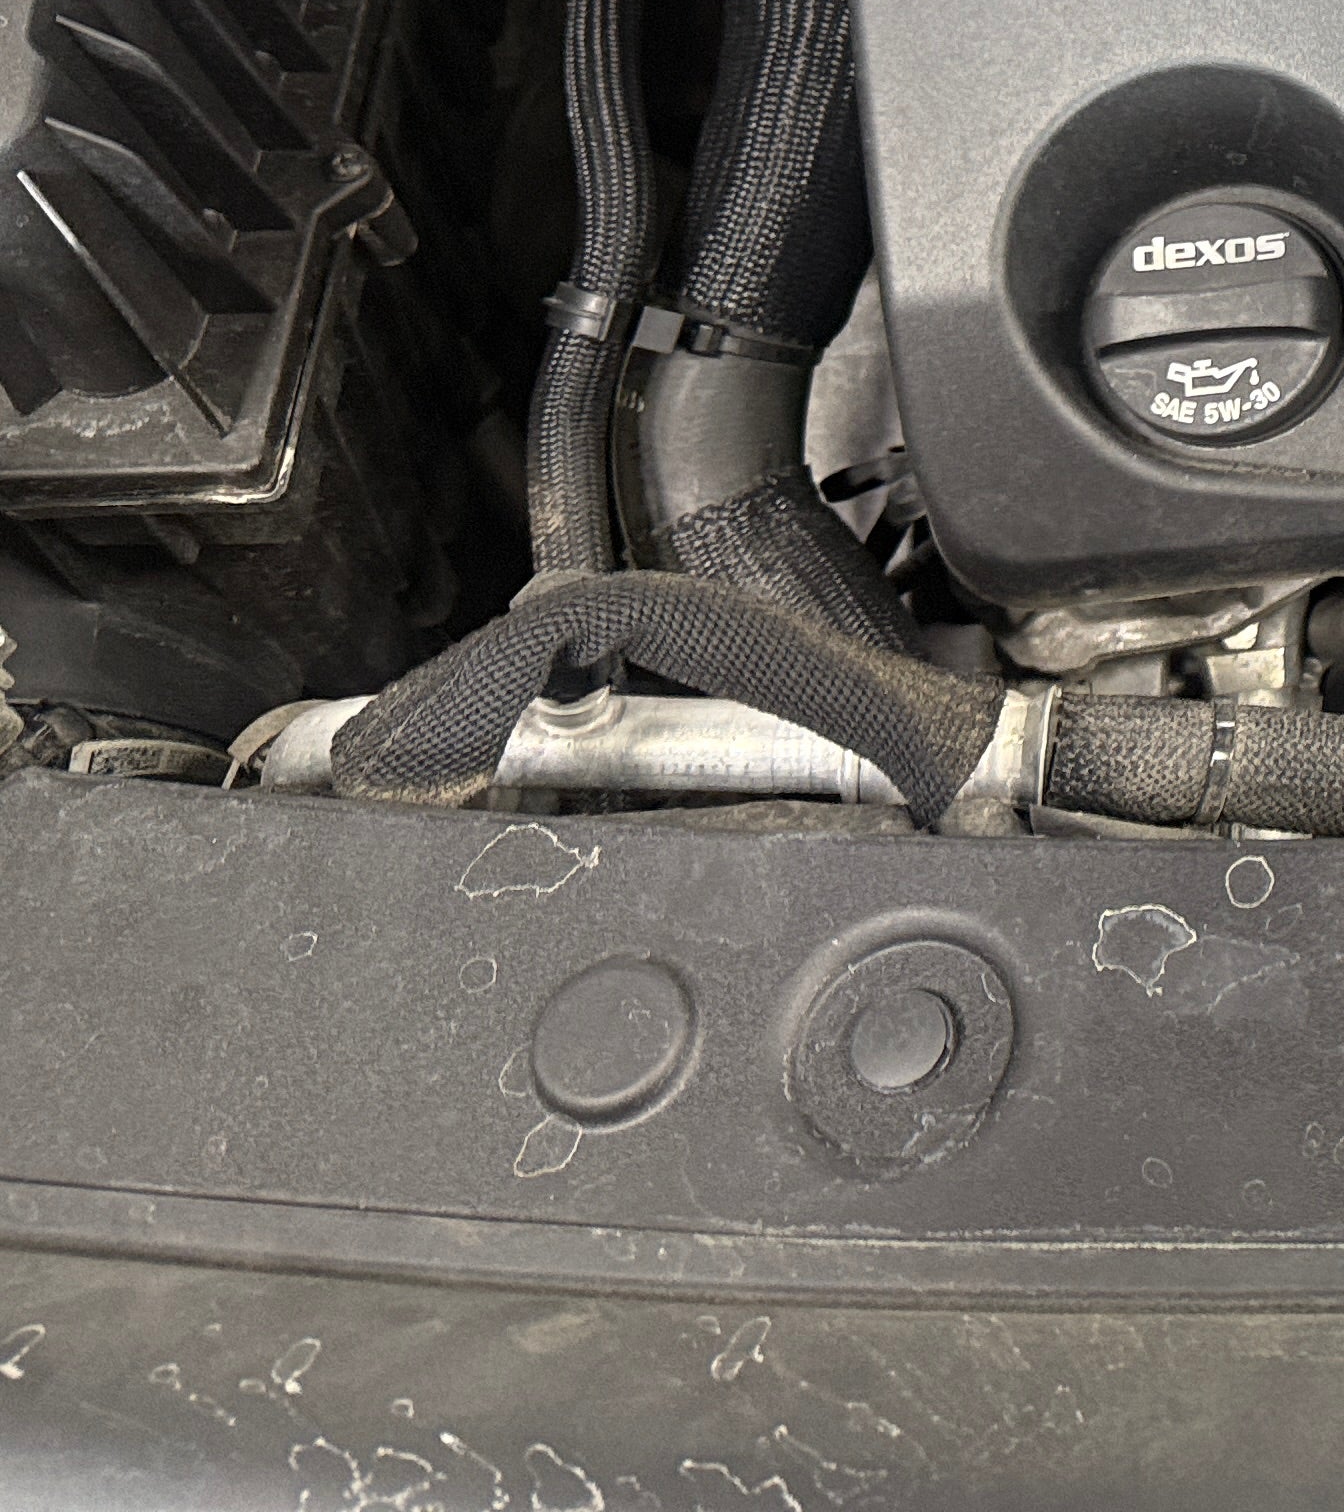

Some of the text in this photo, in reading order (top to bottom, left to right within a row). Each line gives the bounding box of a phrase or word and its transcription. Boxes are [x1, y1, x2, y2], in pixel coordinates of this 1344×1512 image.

[1132, 232, 1288, 272] dexos
[1150, 381, 1282, 425] SAE 5W-30
